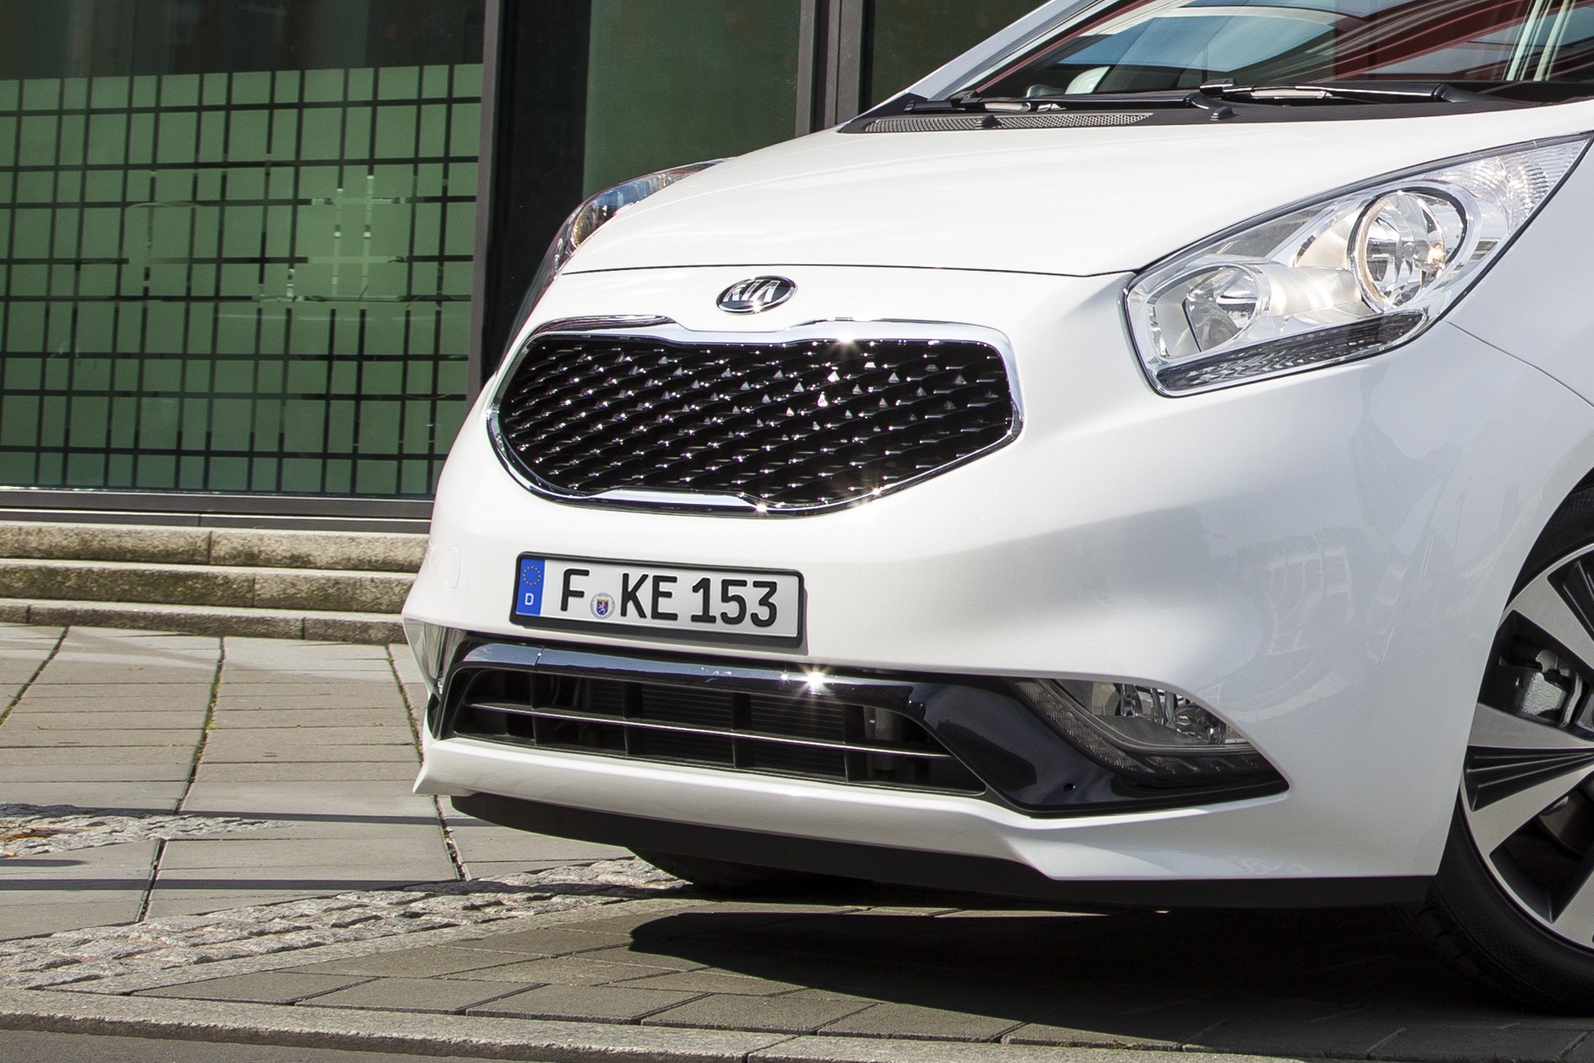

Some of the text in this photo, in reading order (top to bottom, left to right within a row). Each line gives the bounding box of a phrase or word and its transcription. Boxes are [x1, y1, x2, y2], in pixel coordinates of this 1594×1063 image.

[722, 278, 781, 302] KIA
[524, 592, 535, 606] D
[560, 568, 778, 627] F KE 153
